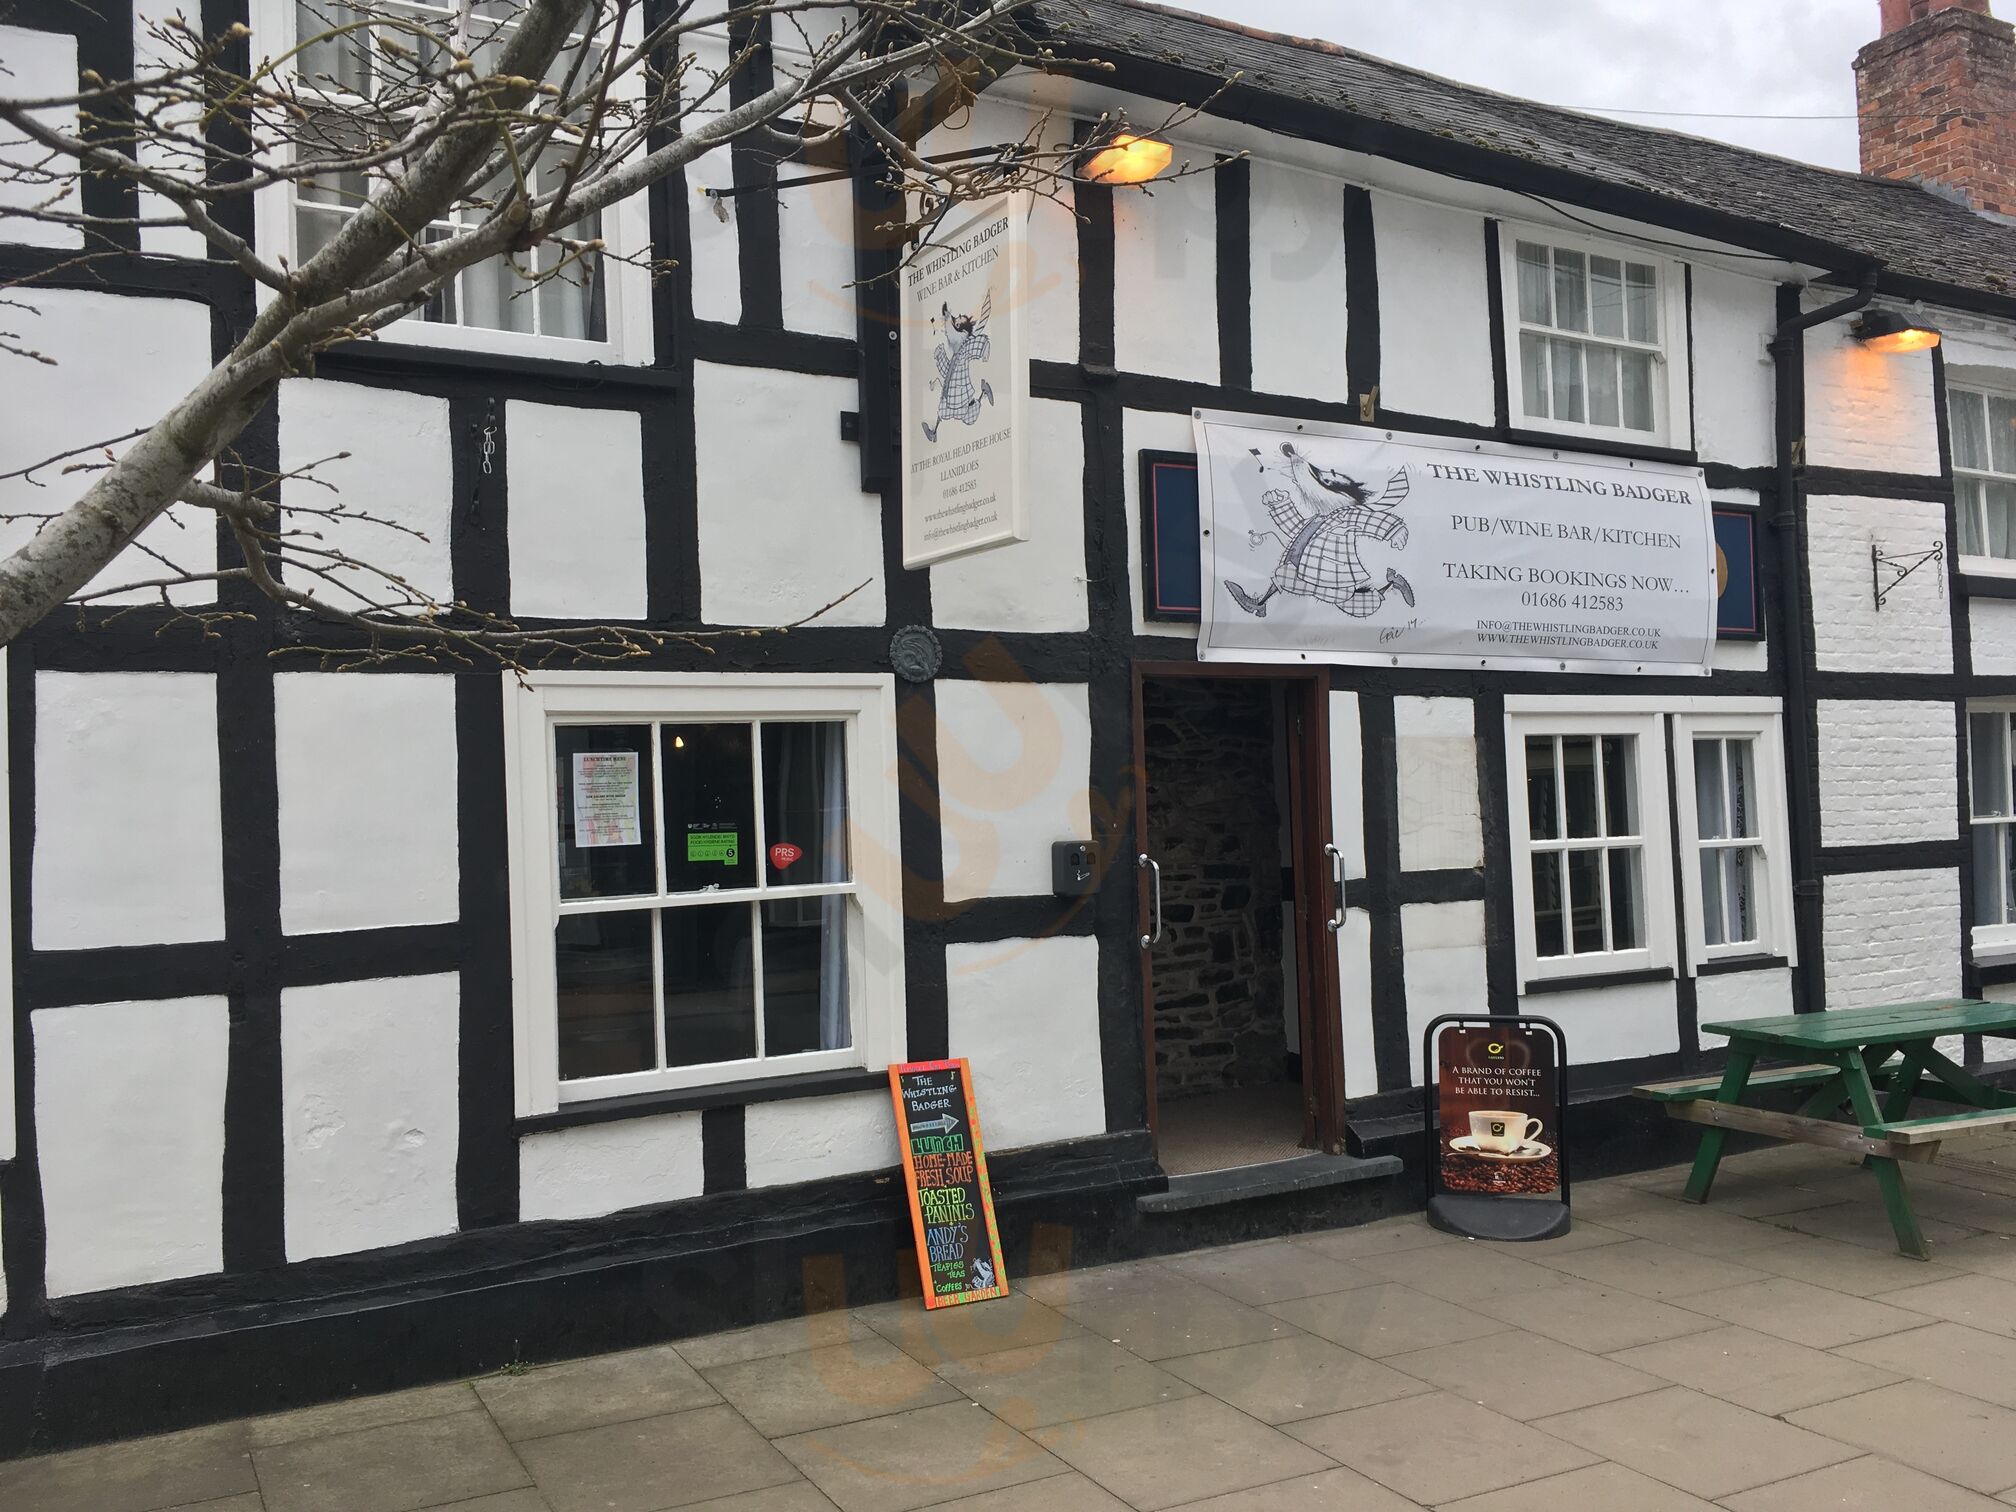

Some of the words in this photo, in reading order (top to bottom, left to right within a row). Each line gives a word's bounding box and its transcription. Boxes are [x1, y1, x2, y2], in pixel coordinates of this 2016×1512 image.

[908, 268, 925, 287] THE
[925, 240, 972, 276] WHISTLING
[973, 217, 1009, 249] BADGER
[916, 282, 937, 302] WINE
[938, 272, 953, 291] BAR
[954, 269, 961, 281] &
[961, 245, 999, 278] KITCHEN
[918, 458, 932, 472] THE
[932, 450, 952, 467] ROYAL
[952, 444, 971, 459] HEAD
[972, 436, 989, 452] FREE
[989, 427, 1012, 446] HOUSE
[940, 459, 980, 481] LLANIDLOES
[1427, 463, 1480, 483] THE
[1482, 469, 1608, 496] WHISTLING
[1612, 483, 1692, 505] BADGER
[1557, 524, 1682, 549] BAR/KITCHEN
[1443, 562, 1523, 583] TAKING
[1528, 568, 1627, 589] BOOKINGS
[1631, 575, 1690, 594] NOW...
[1521, 592, 1567, 608] 01686
[1572, 595, 1624, 612] 412583
[1477, 619, 1661, 638] INFO@THEWHISTLINGBADGER.CO.UK
[1477, 633, 1659, 650] WWW.THEWHISTLINGBADGER.CO.UK
[775, 847, 794, 857] PRS
[912, 1075, 933, 1086] THE
[1452, 1066, 1459, 1074] A
[1461, 1066, 1492, 1075] BRAND
[1494, 1067, 1506, 1075] OF
[1508, 1068, 1542, 1077] COFFEE
[1458, 1076, 1482, 1085] THAT
[1483, 1077, 1503, 1086] YOU
[1505, 1078, 1536, 1086] WON'T
[902, 1084, 957, 1099] WHISTLING
[1467, 1087, 1488, 1095] ABLE
[1490, 1088, 1503, 1096] TO
[1505, 1088, 1540, 1097] RESIST...
[911, 1098, 952, 1112] BADGER
[913, 1151, 973, 1170] HOME-MADE
[915, 1168, 945, 1187] FRESH
[945, 1165, 974, 1185] SOUP
[918, 1187, 966, 1207] TOASTED
[924, 1203, 975, 1224] PANINIS
[927, 1222, 969, 1246] ANDY'S
[929, 1242, 964, 1263] BREAD
[947, 1270, 966, 1279] TEAS
